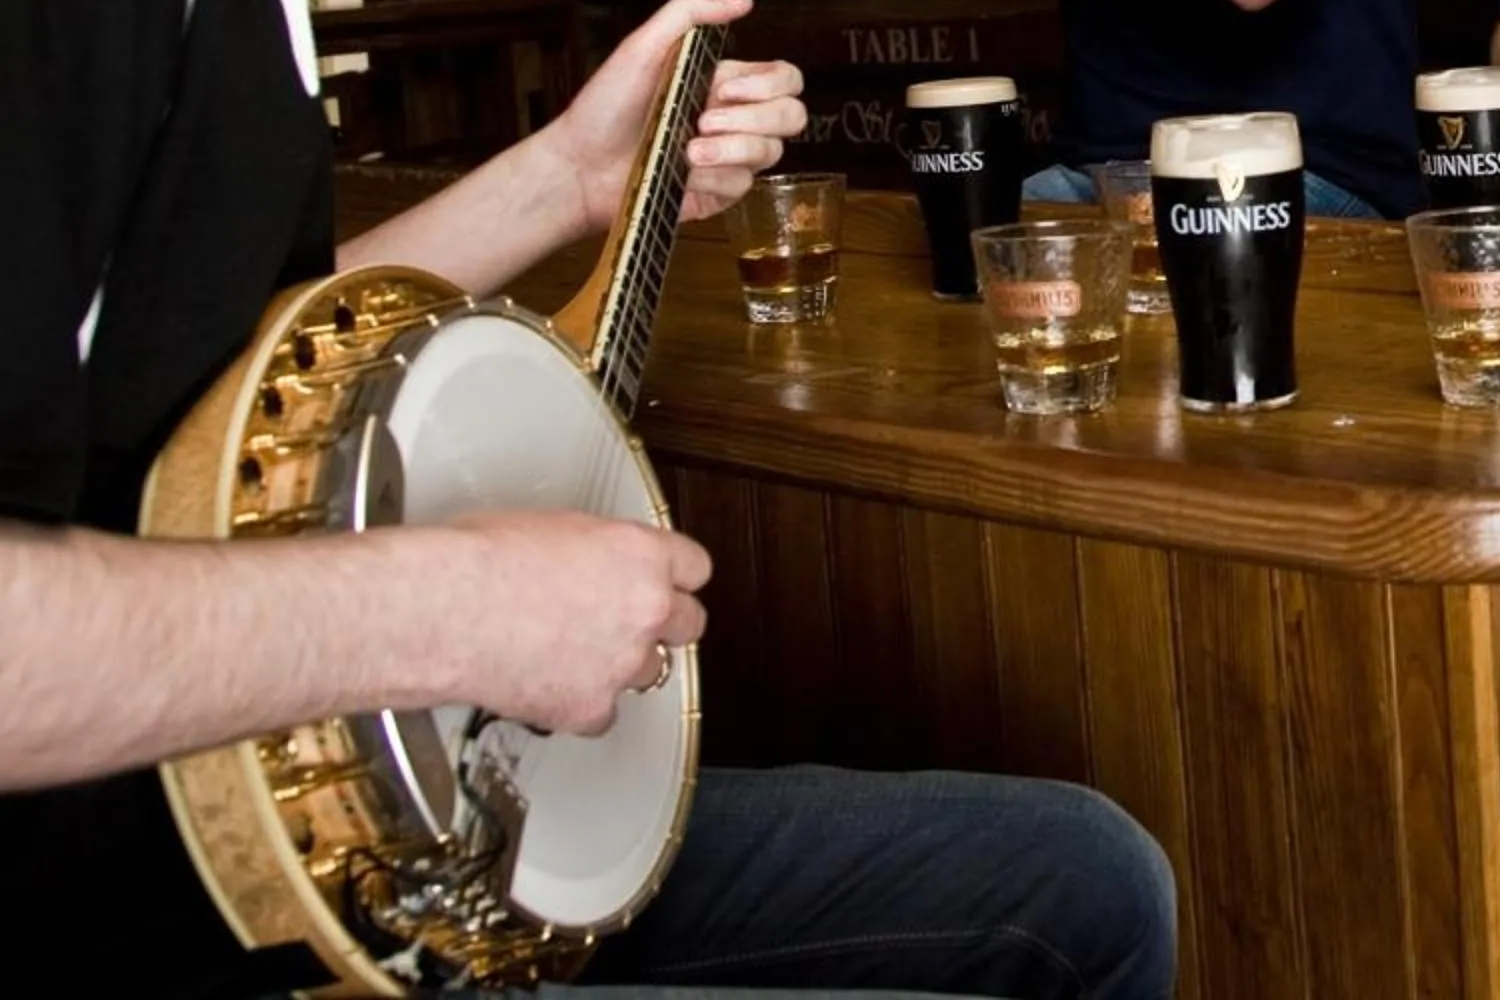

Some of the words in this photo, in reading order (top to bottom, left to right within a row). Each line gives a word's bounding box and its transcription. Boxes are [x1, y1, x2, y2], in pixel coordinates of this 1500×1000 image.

[841, 25, 955, 64] TABLE
[911, 150, 985, 173] UINNESS
[1170, 201, 1291, 235] GUINNESS
